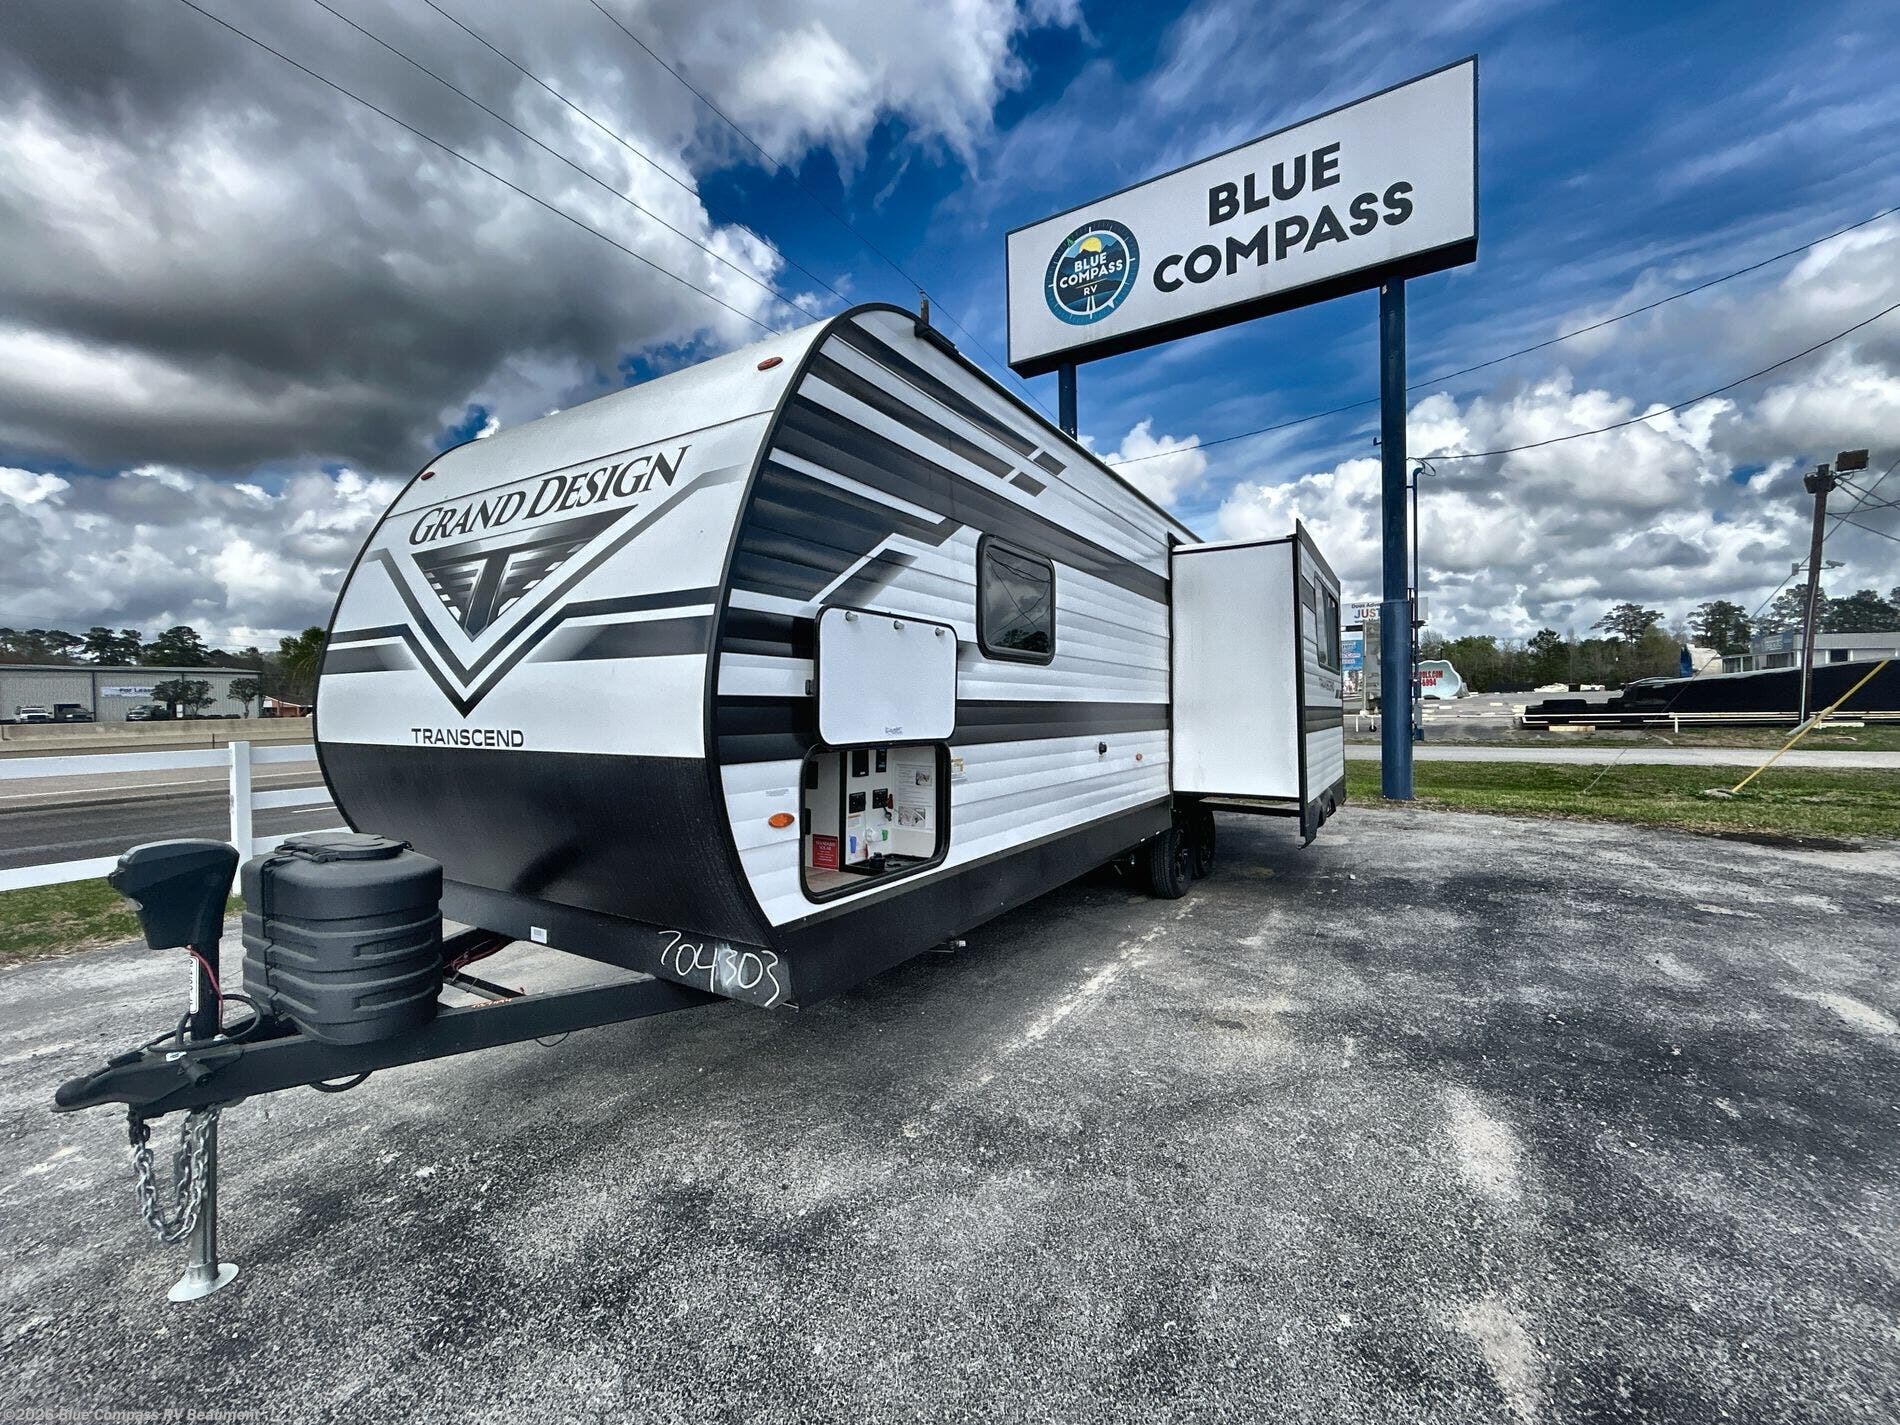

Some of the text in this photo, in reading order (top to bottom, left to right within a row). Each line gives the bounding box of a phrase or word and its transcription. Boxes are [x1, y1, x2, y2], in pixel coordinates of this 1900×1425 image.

[1209, 142, 1341, 226] BLUE
[1074, 251, 1108, 274] BLUE
[1153, 181, 1413, 293] COMPASS
[1059, 257, 1124, 289] COMPASS
[1083, 283, 1098, 297] RV
[408, 444, 692, 546] GRAND DESIGN
[411, 728, 525, 748] TRANSCEND
[658, 930, 780, 1008] 704303
